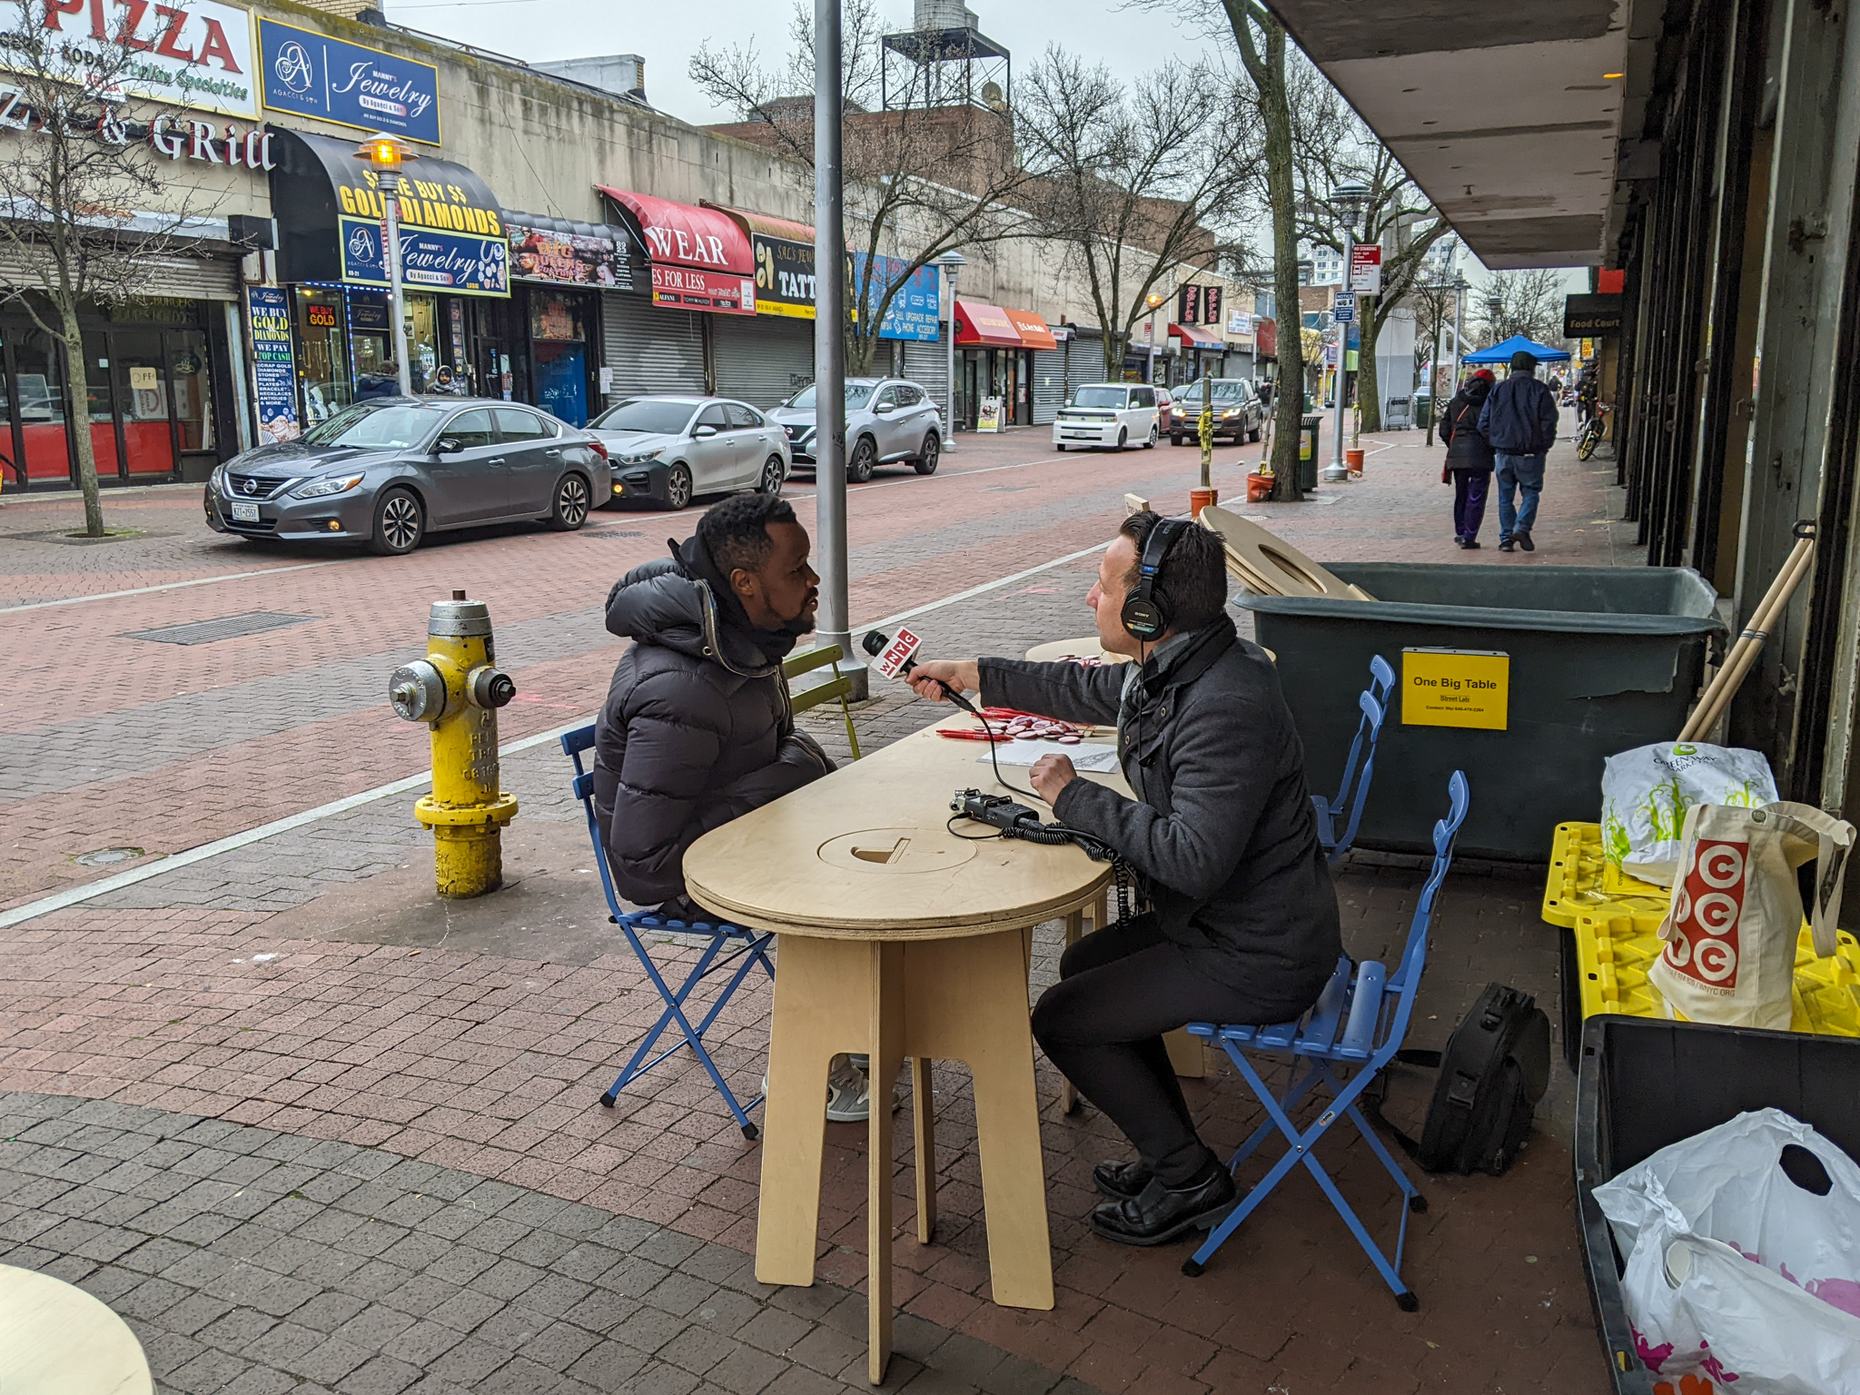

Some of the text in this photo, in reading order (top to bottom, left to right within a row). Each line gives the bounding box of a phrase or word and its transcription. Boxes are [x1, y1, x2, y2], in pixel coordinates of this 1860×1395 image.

[43, 0, 243, 74] PIZZA
[332, 61, 432, 118] Jewelry
[413, 179, 446, 202] BUY
[399, 195, 501, 236] DIAMONDS
[418, 242, 444, 252] MANNY'S
[643, 226, 729, 266] WEAR
[417, 272, 435, 281] Agacci
[664, 270, 684, 289] FOR
[685, 273, 705, 291] LESS
[252, 306, 288, 318] WE BUY
[252, 315, 289, 330] GOLD
[309, 314, 335, 326] GOLD
[1570, 318, 1621, 328] Food Court
[254, 329, 290, 342] DIAMONDS
[257, 343, 288, 352] WE PAY
[880, 634, 914, 673] WNYC
[1413, 676, 1497, 690] One Big Table
